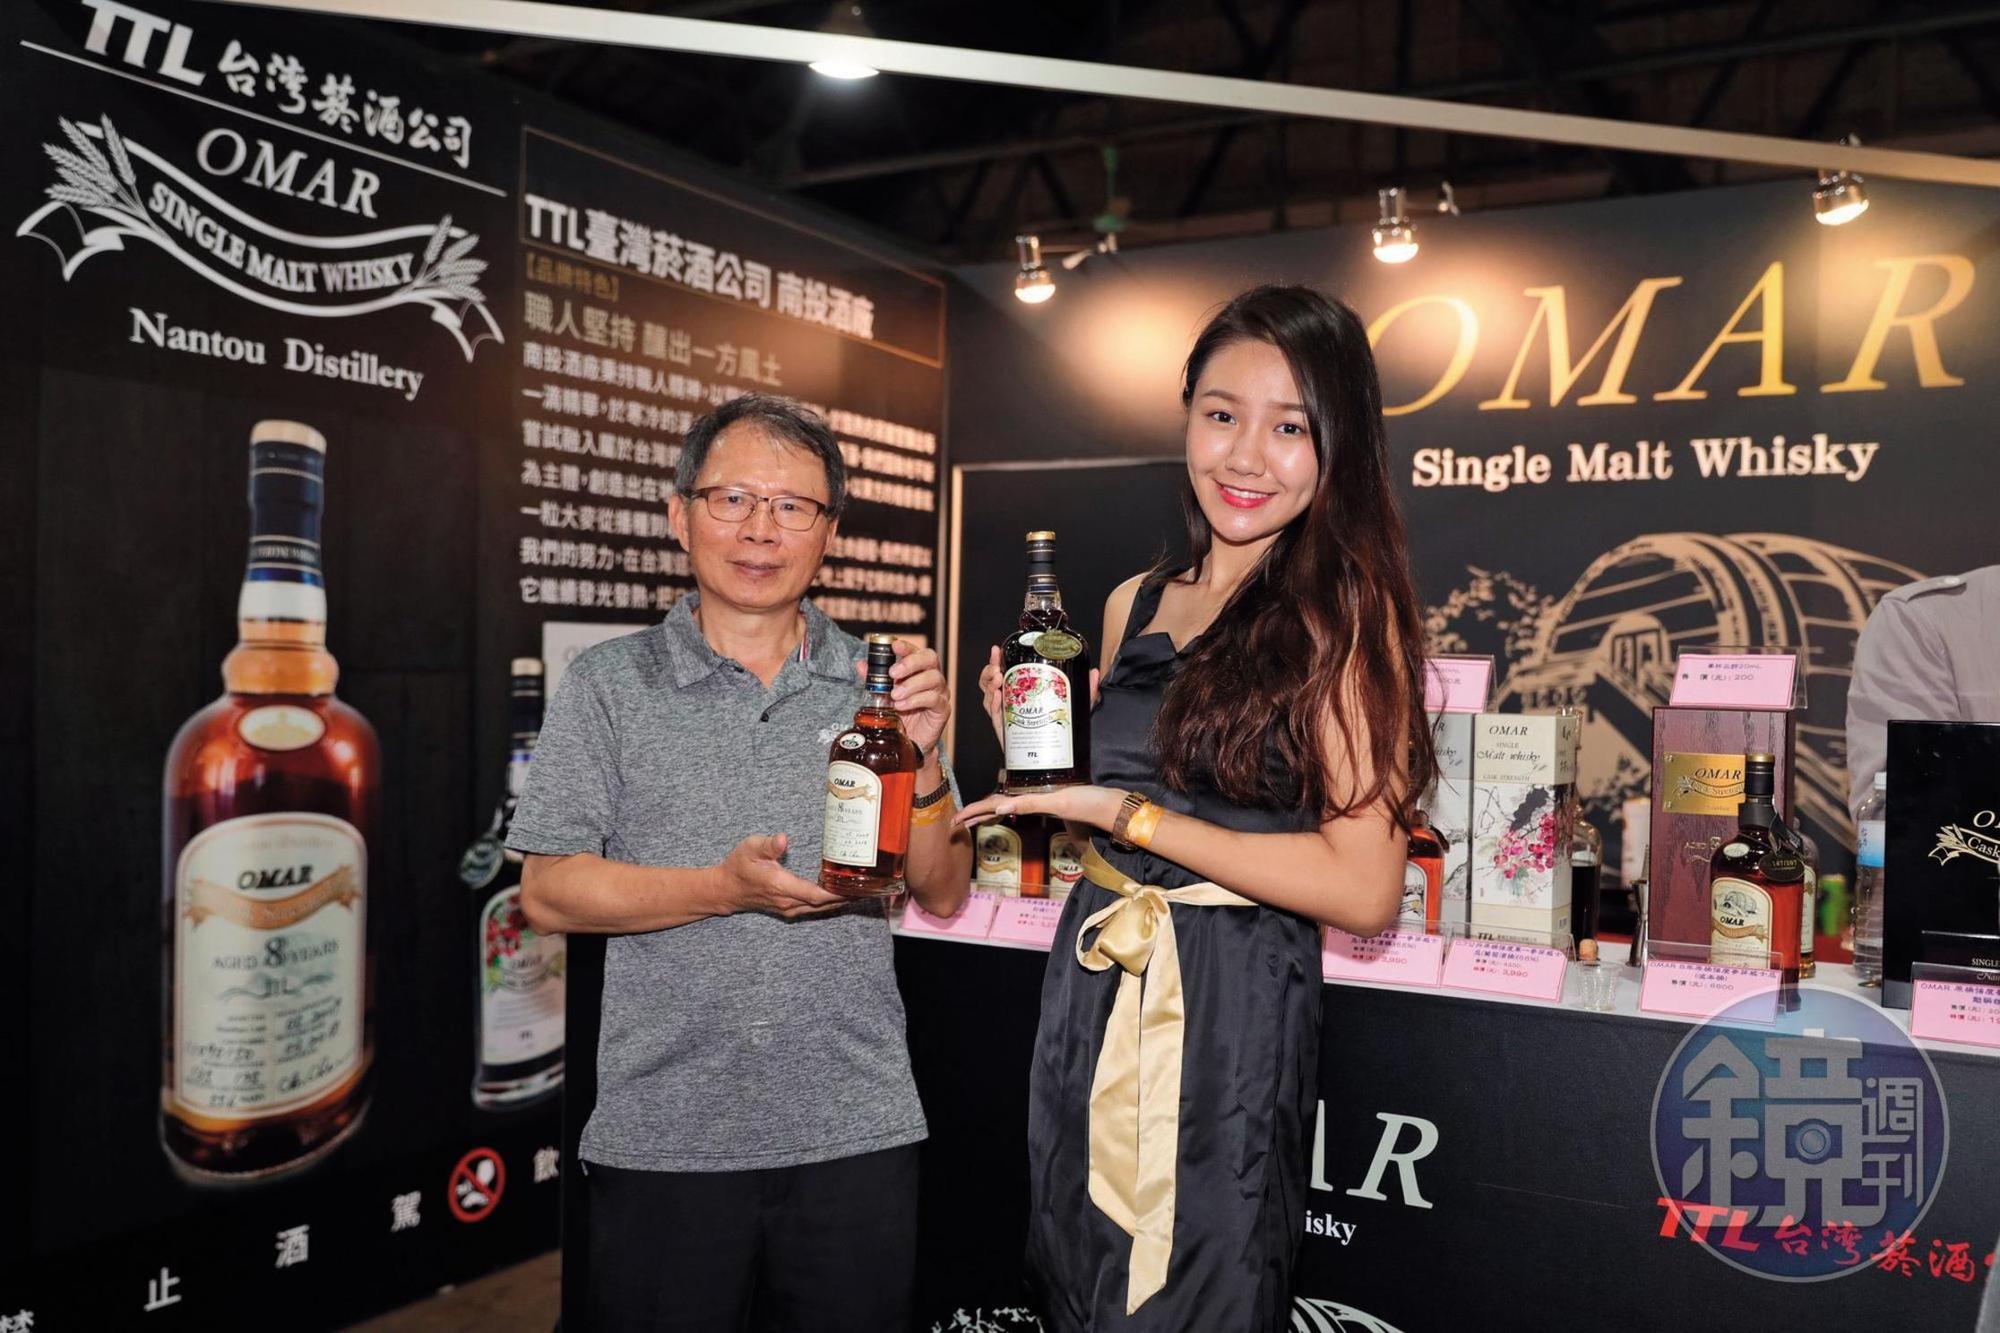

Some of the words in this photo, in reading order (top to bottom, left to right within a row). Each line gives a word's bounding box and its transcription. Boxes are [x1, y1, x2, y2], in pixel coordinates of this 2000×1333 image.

[81, 0, 207, 86] TTL
[196, 128, 382, 219] OMAR
[148, 181, 248, 271] SINGLE
[246, 252, 319, 293] MALT
[320, 253, 415, 294] WHISKY
[523, 290, 637, 354] 職人堅持
[1368, 253, 1976, 417] OMAR
[128, 306, 267, 365] Nantou
[283, 338, 425, 401] Distillery
[1412, 446, 1552, 493] Single
[1566, 439, 1674, 484] Malt
[1690, 433, 1881, 483] Whisky
[1488, 725, 1529, 736] OMAR
[833, 777, 856, 788] OMAR
[1694, 767, 1742, 780] OMAR
[237, 863, 315, 891] OMAR
[1720, 915, 1745, 927] OMAR
[1920, 982, 1951, 992] OMAR
[1656, 1197, 1760, 1253] TTL
